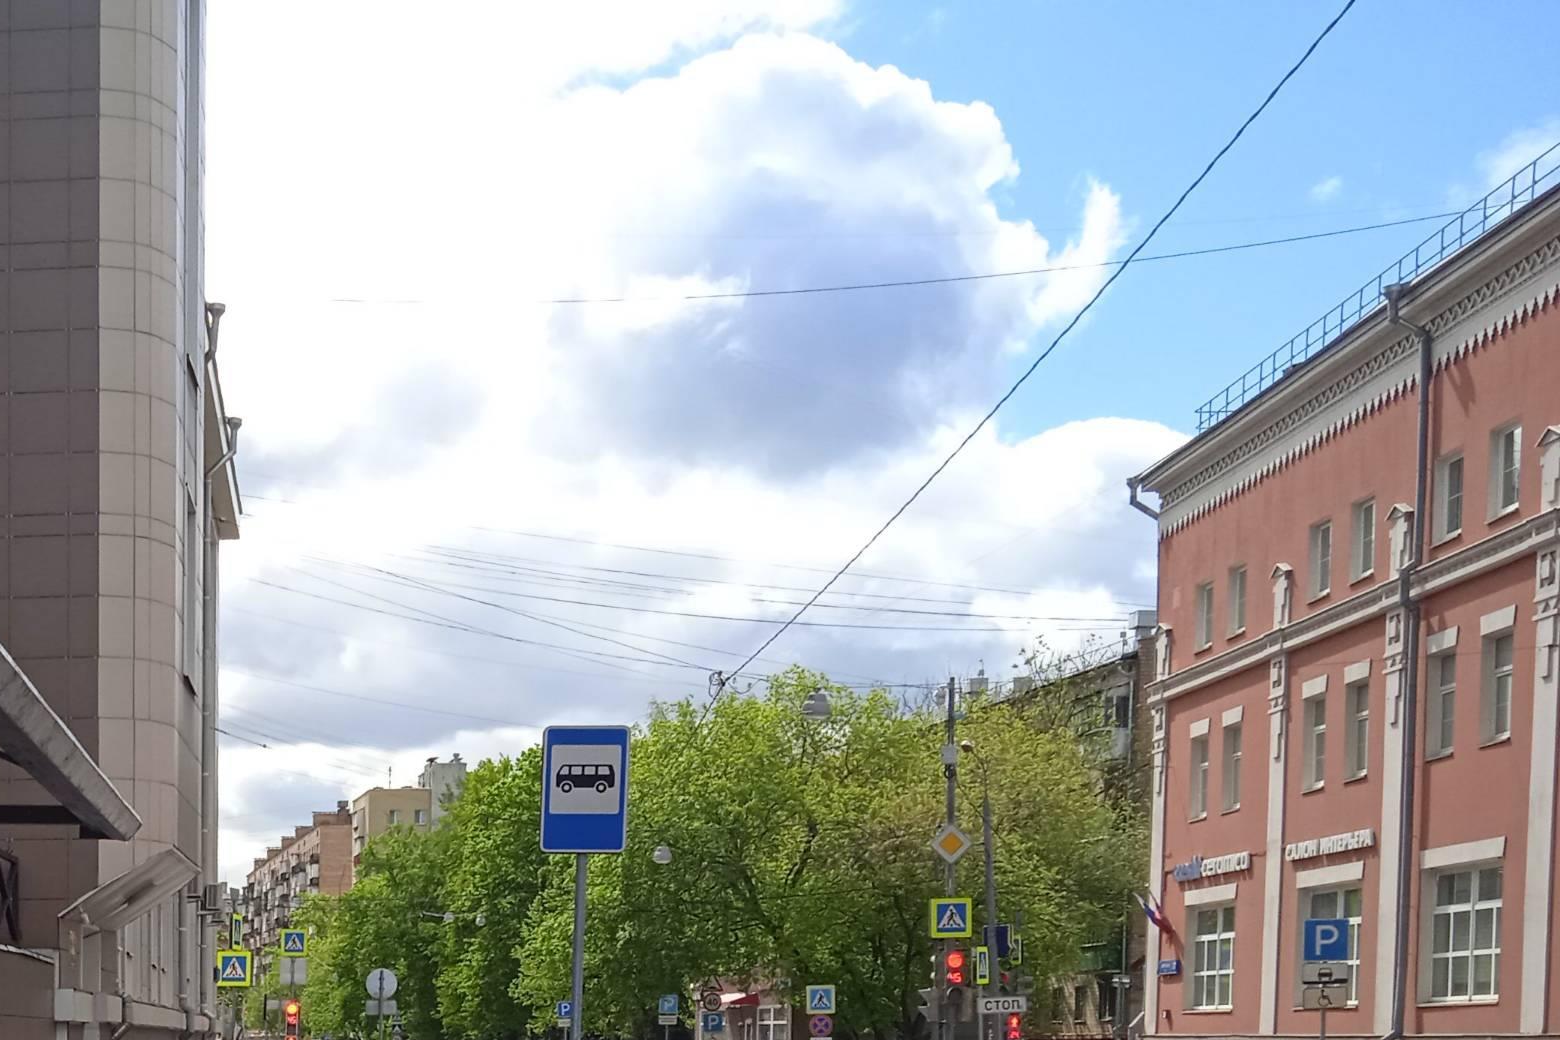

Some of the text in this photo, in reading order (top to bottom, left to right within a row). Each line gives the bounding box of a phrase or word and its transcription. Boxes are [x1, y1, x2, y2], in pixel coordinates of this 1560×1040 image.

[1285, 839, 1319, 862] САЛОН
[1315, 925, 1339, 956] P
[561, 1003, 570, 1016] P
[984, 1000, 1020, 1011] СТОП
[708, 1015, 719, 1030] P
